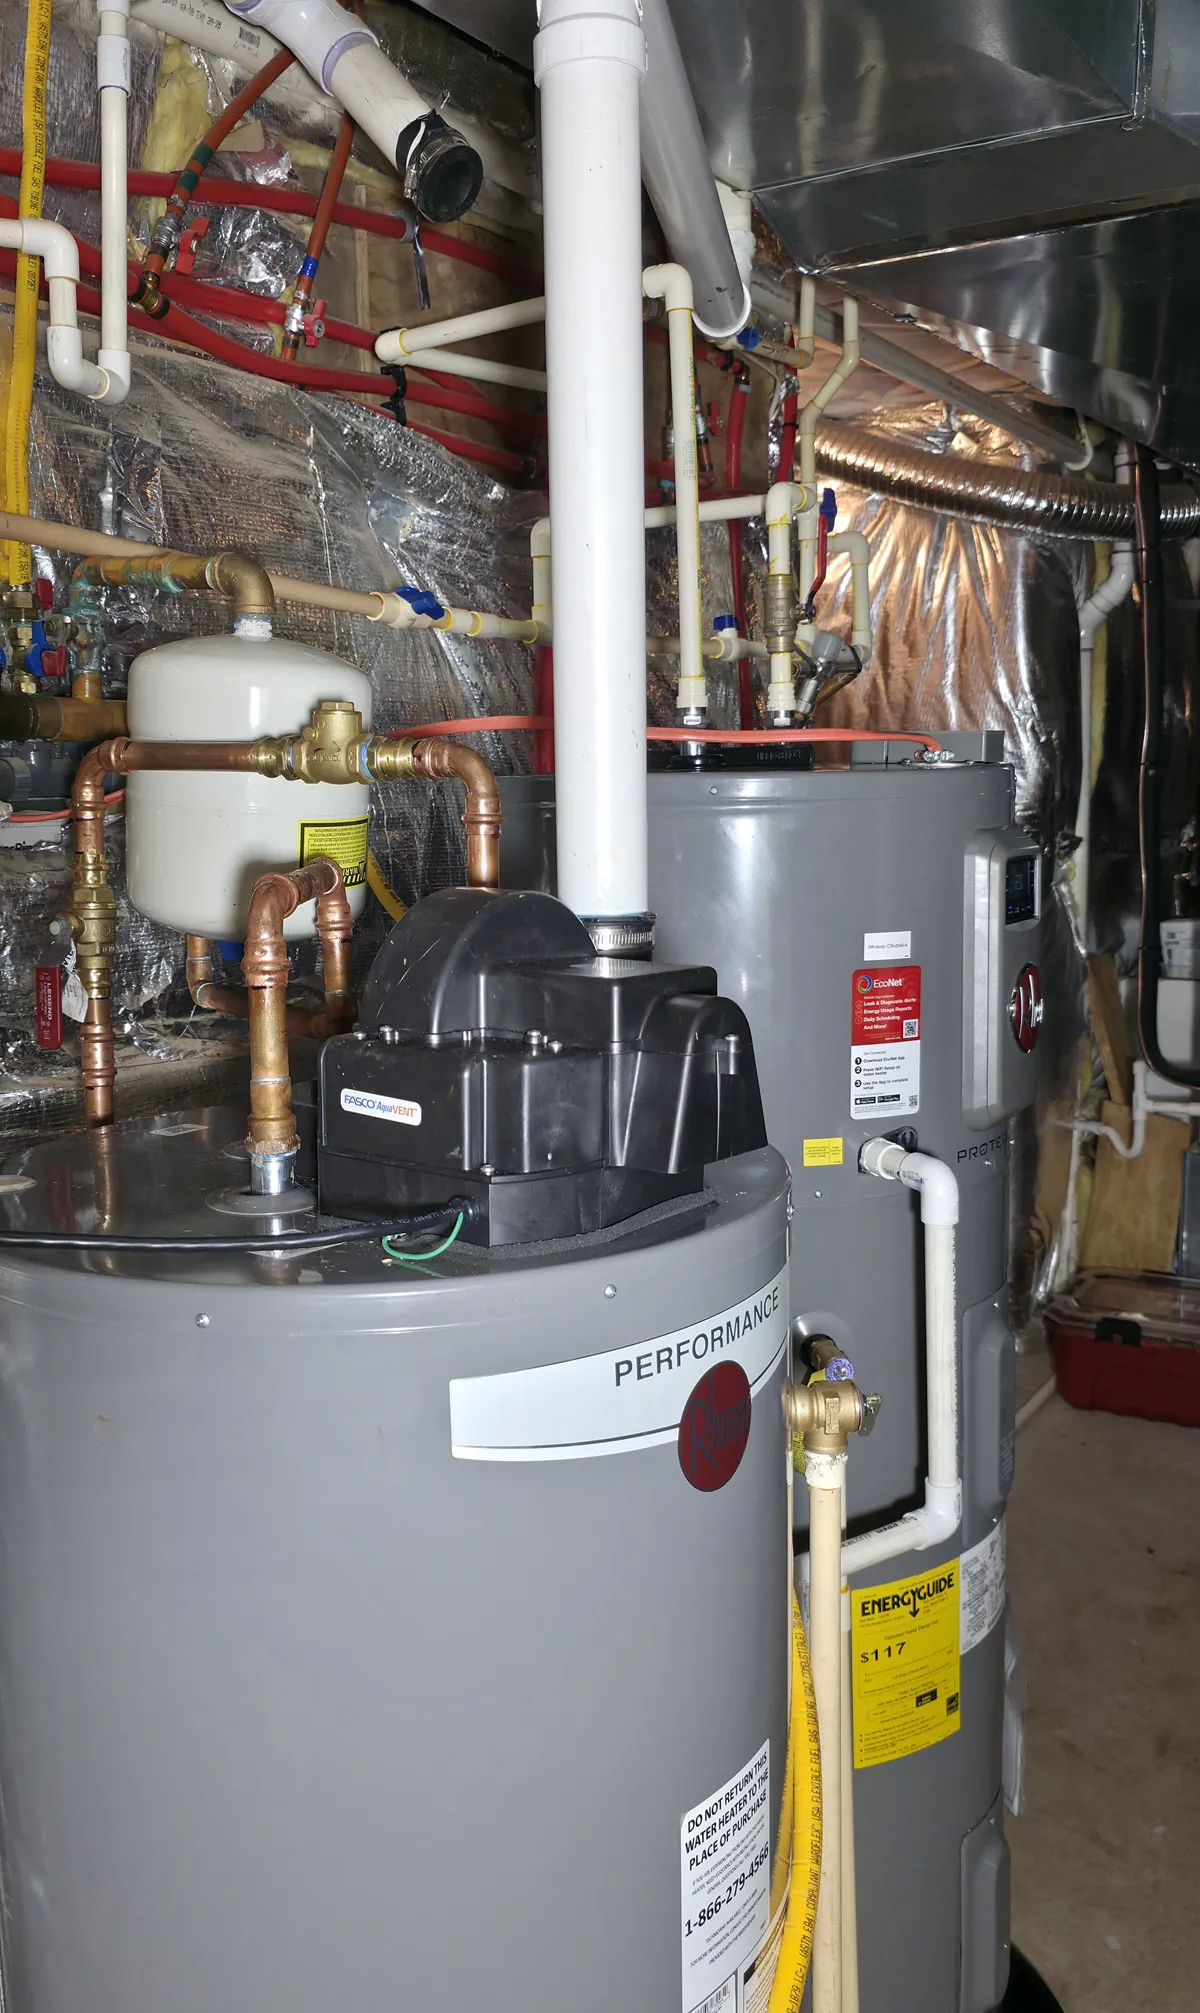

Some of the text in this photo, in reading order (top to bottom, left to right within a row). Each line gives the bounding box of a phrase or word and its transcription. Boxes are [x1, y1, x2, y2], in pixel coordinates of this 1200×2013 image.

[32, 160, 42, 174] FUEL
[31, 177, 41, 188] GAS
[873, 978, 903, 988] EcoNet
[344, 1094, 375, 1109] FASCO
[614, 1286, 779, 1388] PERFORMANCE
[689, 1368, 750, 1476] Rheem
[861, 1572, 955, 1617] ENERGYGUIDE
[860, 1641, 906, 1664] $117
[805, 1700, 818, 1727] TUBING
[808, 1729, 820, 1744] GAS
[809, 1747, 821, 1765] FUEL
[687, 1751, 767, 1833] DO NOT RETURN THIS
[810, 1767, 821, 1804] FLEXIBLE
[685, 1822, 717, 1854] WATER
[718, 1795, 748, 1830] HEATER
[748, 1783, 757, 1800] TO
[757, 1767, 769, 1790] THE
[811, 1806, 821, 1821] USA
[689, 1840, 718, 1871] PLACE
[720, 1828, 731, 1847] OF
[732, 1789, 767, 1836] PURCHASE
[684, 1841, 769, 1937] 1-866-279-4566
[805, 1868, 820, 1911] COMPLIANT
[802, 1913, 815, 1934] E84)
[798, 1935, 810, 1960] (ASTM
[794, 1963, 806, 1984] LC-1
